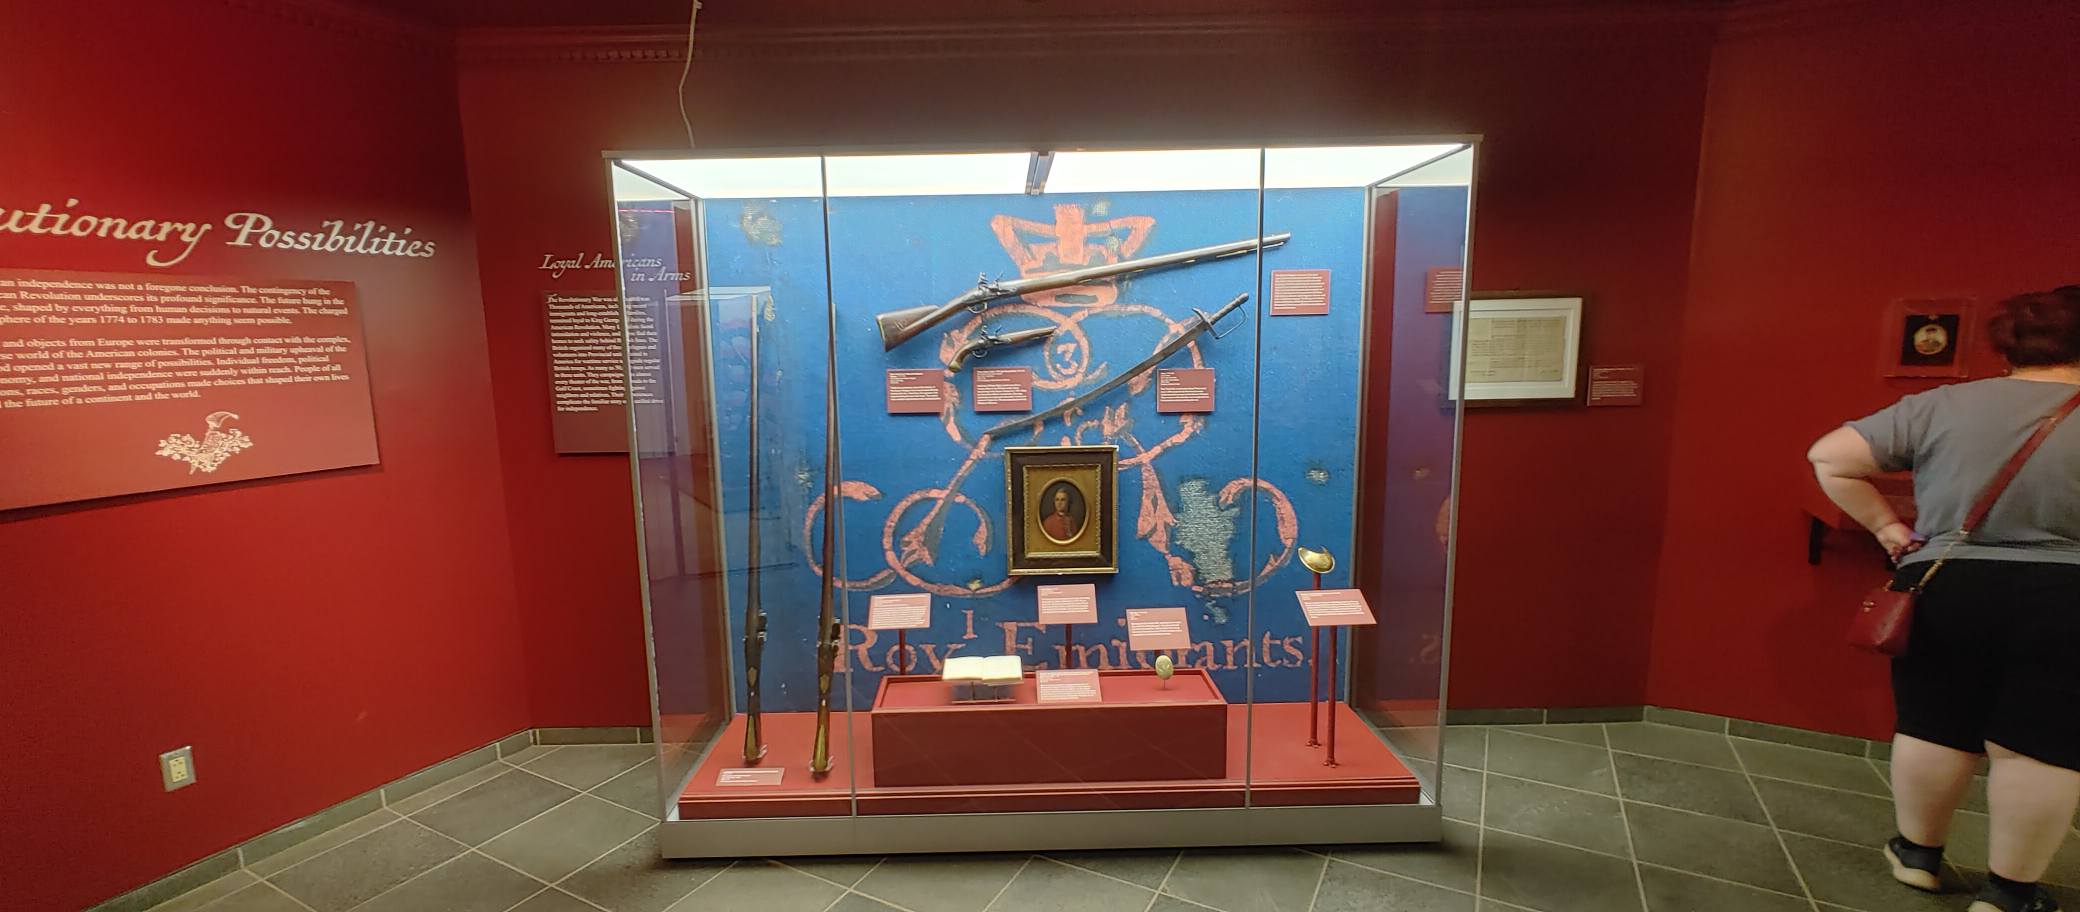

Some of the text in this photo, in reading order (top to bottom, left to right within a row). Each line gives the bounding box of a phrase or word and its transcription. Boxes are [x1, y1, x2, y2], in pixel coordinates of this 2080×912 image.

[223, 212, 436, 258] Possibilities
[538, 252, 584, 279] Loyal
[630, 266, 691, 282] in Arms
[17, 279, 93, 290] independence
[118, 282, 134, 290] not
[145, 282, 186, 293] foregone
[241, 285, 258, 293] The
[308, 287, 318, 295] of
[318, 287, 331, 295] the
[19, 291, 81, 300] Revolution
[84, 292, 145, 301] underscores
[146, 293, 158, 301] its
[160, 294, 202, 304] profound
[260, 295, 276, 304] The
[278, 296, 301, 304] future
[14, 303, 52, 314] shaped
[55, 304, 69, 314] by
[72, 304, 128, 314] everything
[129, 304, 153, 312] from
[156, 304, 187, 312] human
[189, 305, 230, 313] decisions
[273, 306, 301, 314] events.
[302, 306, 318, 314] The
[33, 315, 48, 323] of
[48, 315, 66, 323] the
[70, 317, 98, 325] years
[99, 315, 124, 323] 1774
[140, 315, 164, 323] 1783
[166, 315, 192, 323] made
[193, 315, 232, 326] anything
[256, 316, 293, 326] possible.
[2, 339, 24, 347] and
[26, 338, 66, 349] objects
[69, 338, 95, 346] from
[97, 337, 135, 348] Europe
[162, 336, 216, 345] transformed
[218, 336, 252, 346] through
[253, 336, 284, 344] contact
[285, 336, 302, 344] with
[303, 336, 316, 344] the
[15, 350, 49, 359] world
[52, 350, 64, 358] of
[66, 350, 83, 358] the
[86, 349, 135, 357] American
[137, 348, 179, 356] colonies.
[181, 347, 201, 355] The
[202, 347, 238, 358] political
[239, 346, 255, 354] and
[334, 344, 347, 352] the
[13, 362, 54, 373] opened
[66, 361, 89, 369] vast
[115, 361, 143, 370] range
[144, 359, 156, 367] of
[158, 357, 214, 369] possibilities.
[216, 356, 259, 365] Individual
[298, 354, 329, 365] political
[39, 373, 59, 382] and
[61, 372, 104, 381] national
[107, 370, 173, 381] independence
[199, 367, 239, 378] suddenly
[240, 366, 268, 374] within
[293, 364, 320, 375] People
[322, 364, 331, 372] of
[332, 364, 341, 372] all
[61, 384, 106, 395] genders,
[108, 382, 127, 391] and
[128, 380, 186, 392] occupations
[188, 379, 211, 387] made
[213, 377, 246, 386] choices
[247, 376, 264, 385] that
[265, 375, 293, 386] shaped
[294, 374, 312, 383] their
[331, 373, 350, 381] lives
[4, 399, 23, 407] the
[26, 397, 59, 406] future
[61, 396, 74, 404] of
[85, 393, 132, 403] continent
[134, 392, 152, 400] and
[154, 391, 170, 399] the
[171, 390, 200, 398] world.
